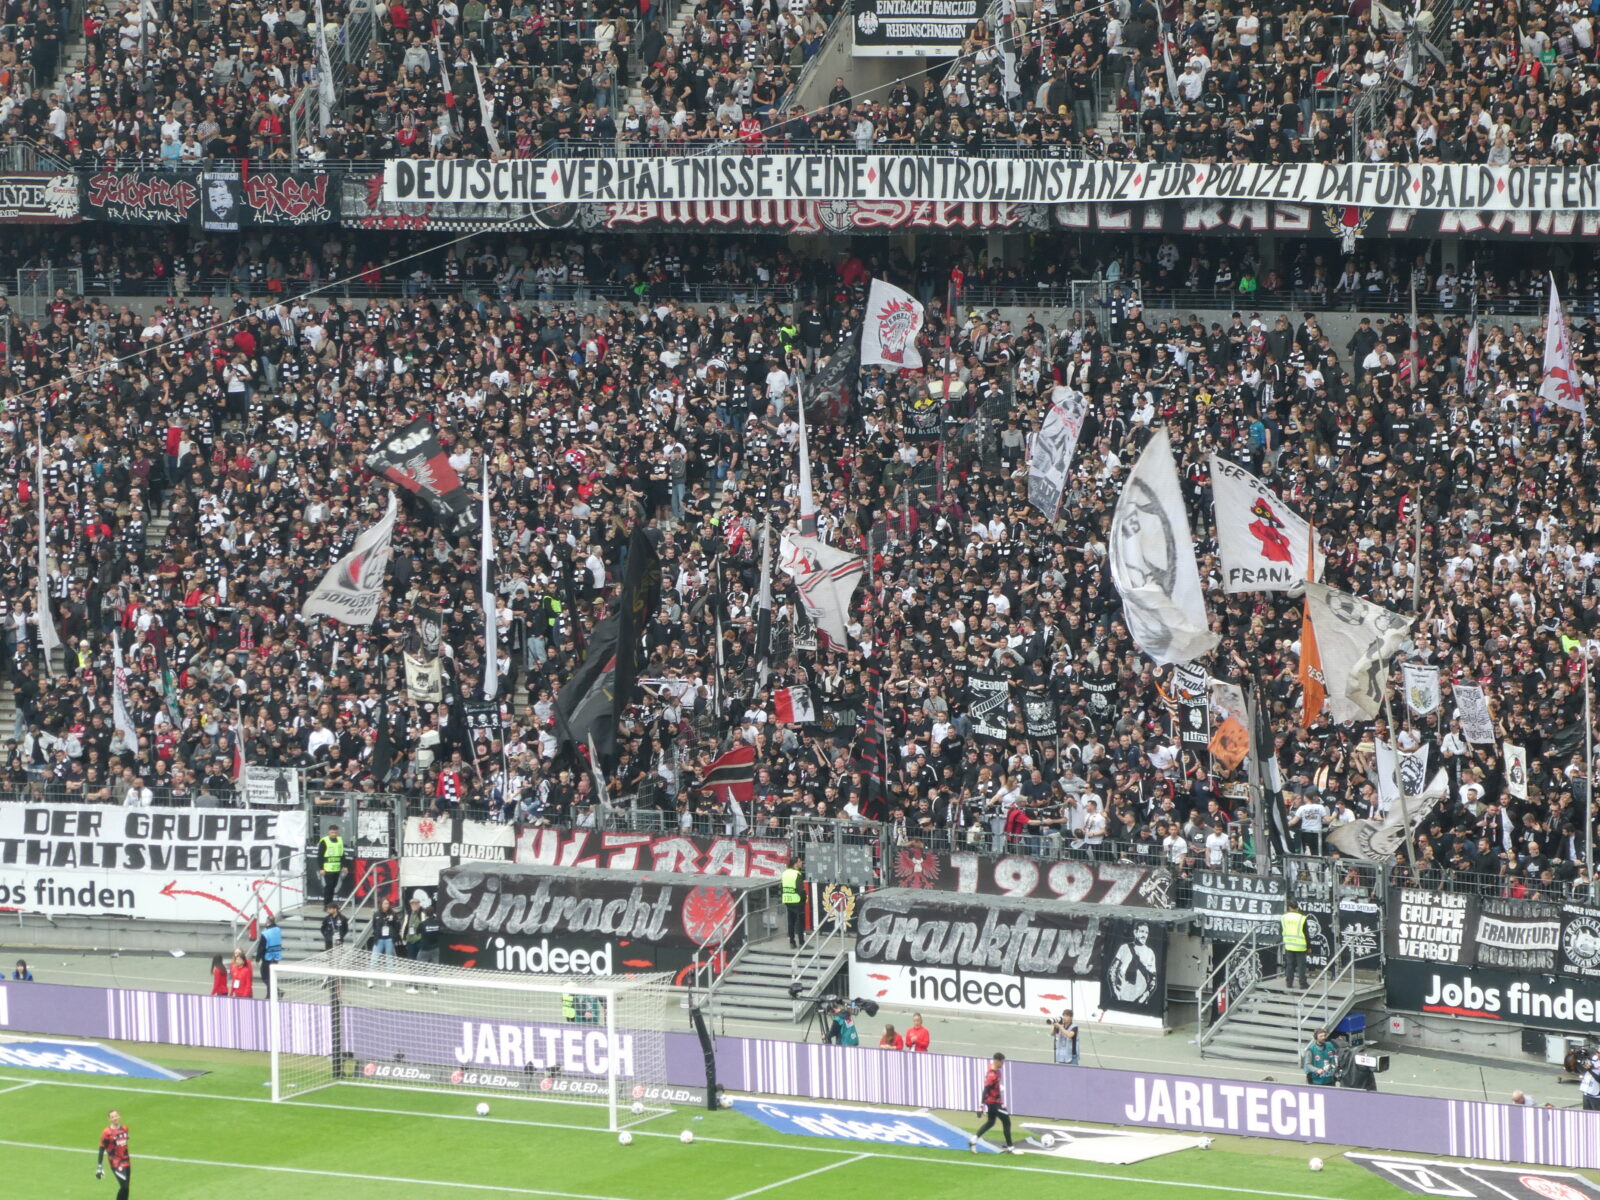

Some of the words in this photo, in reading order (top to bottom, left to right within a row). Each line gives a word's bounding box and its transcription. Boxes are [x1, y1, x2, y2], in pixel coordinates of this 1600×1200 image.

[876, 1, 931, 14] EINTRACHT
[932, 1, 977, 15] FANCLUB
[886, 24, 966, 38] RHEINSCHNAKEN
[247, 173, 329, 217] CREW
[396, 158, 546, 200] DEUTSCHE
[786, 156, 866, 198] KEINE
[879, 156, 1137, 201] KONTROLLINSTANZ
[1143, 163, 1190, 199] FÜR
[1200, 163, 1309, 203] POLIZEI,
[1316, 164, 1410, 206] DAFÜR
[1420, 165, 1495, 207] BALD
[24, 808, 102, 838] DER
[125, 812, 279, 843] GRUPPE
[451, 844, 506, 861] GUARDIA
[950, 851, 1147, 905] 1997
[1202, 873, 1279, 894] ULTRAS
[34, 878, 136, 909] finden
[441, 872, 673, 941] Eintracht
[1206, 895, 1273, 914] NEVER
[1400, 904, 1466, 929] GRUPPE
[856, 897, 1102, 976] Frankfurt
[1399, 923, 1463, 945] STADION
[1482, 921, 1559, 946] FRANKFURT
[495, 937, 612, 977] indeed
[1398, 939, 1462, 963] VERBOT
[909, 966, 1026, 1009] indeed
[1424, 974, 1501, 1012] Jobs
[0, 1046, 128, 1075] ndeed
[454, 1022, 634, 1077] JARLTECH
[375, 1066, 390, 1077] LG
[392, 1067, 419, 1079] OLED
[463, 1073, 477, 1084] LG
[479, 1074, 507, 1087] OLED
[552, 1080, 567, 1091] LG
[644, 1087, 659, 1099] LG
[661, 1089, 689, 1102] OLED
[1125, 1077, 1326, 1138] JARLTECH
